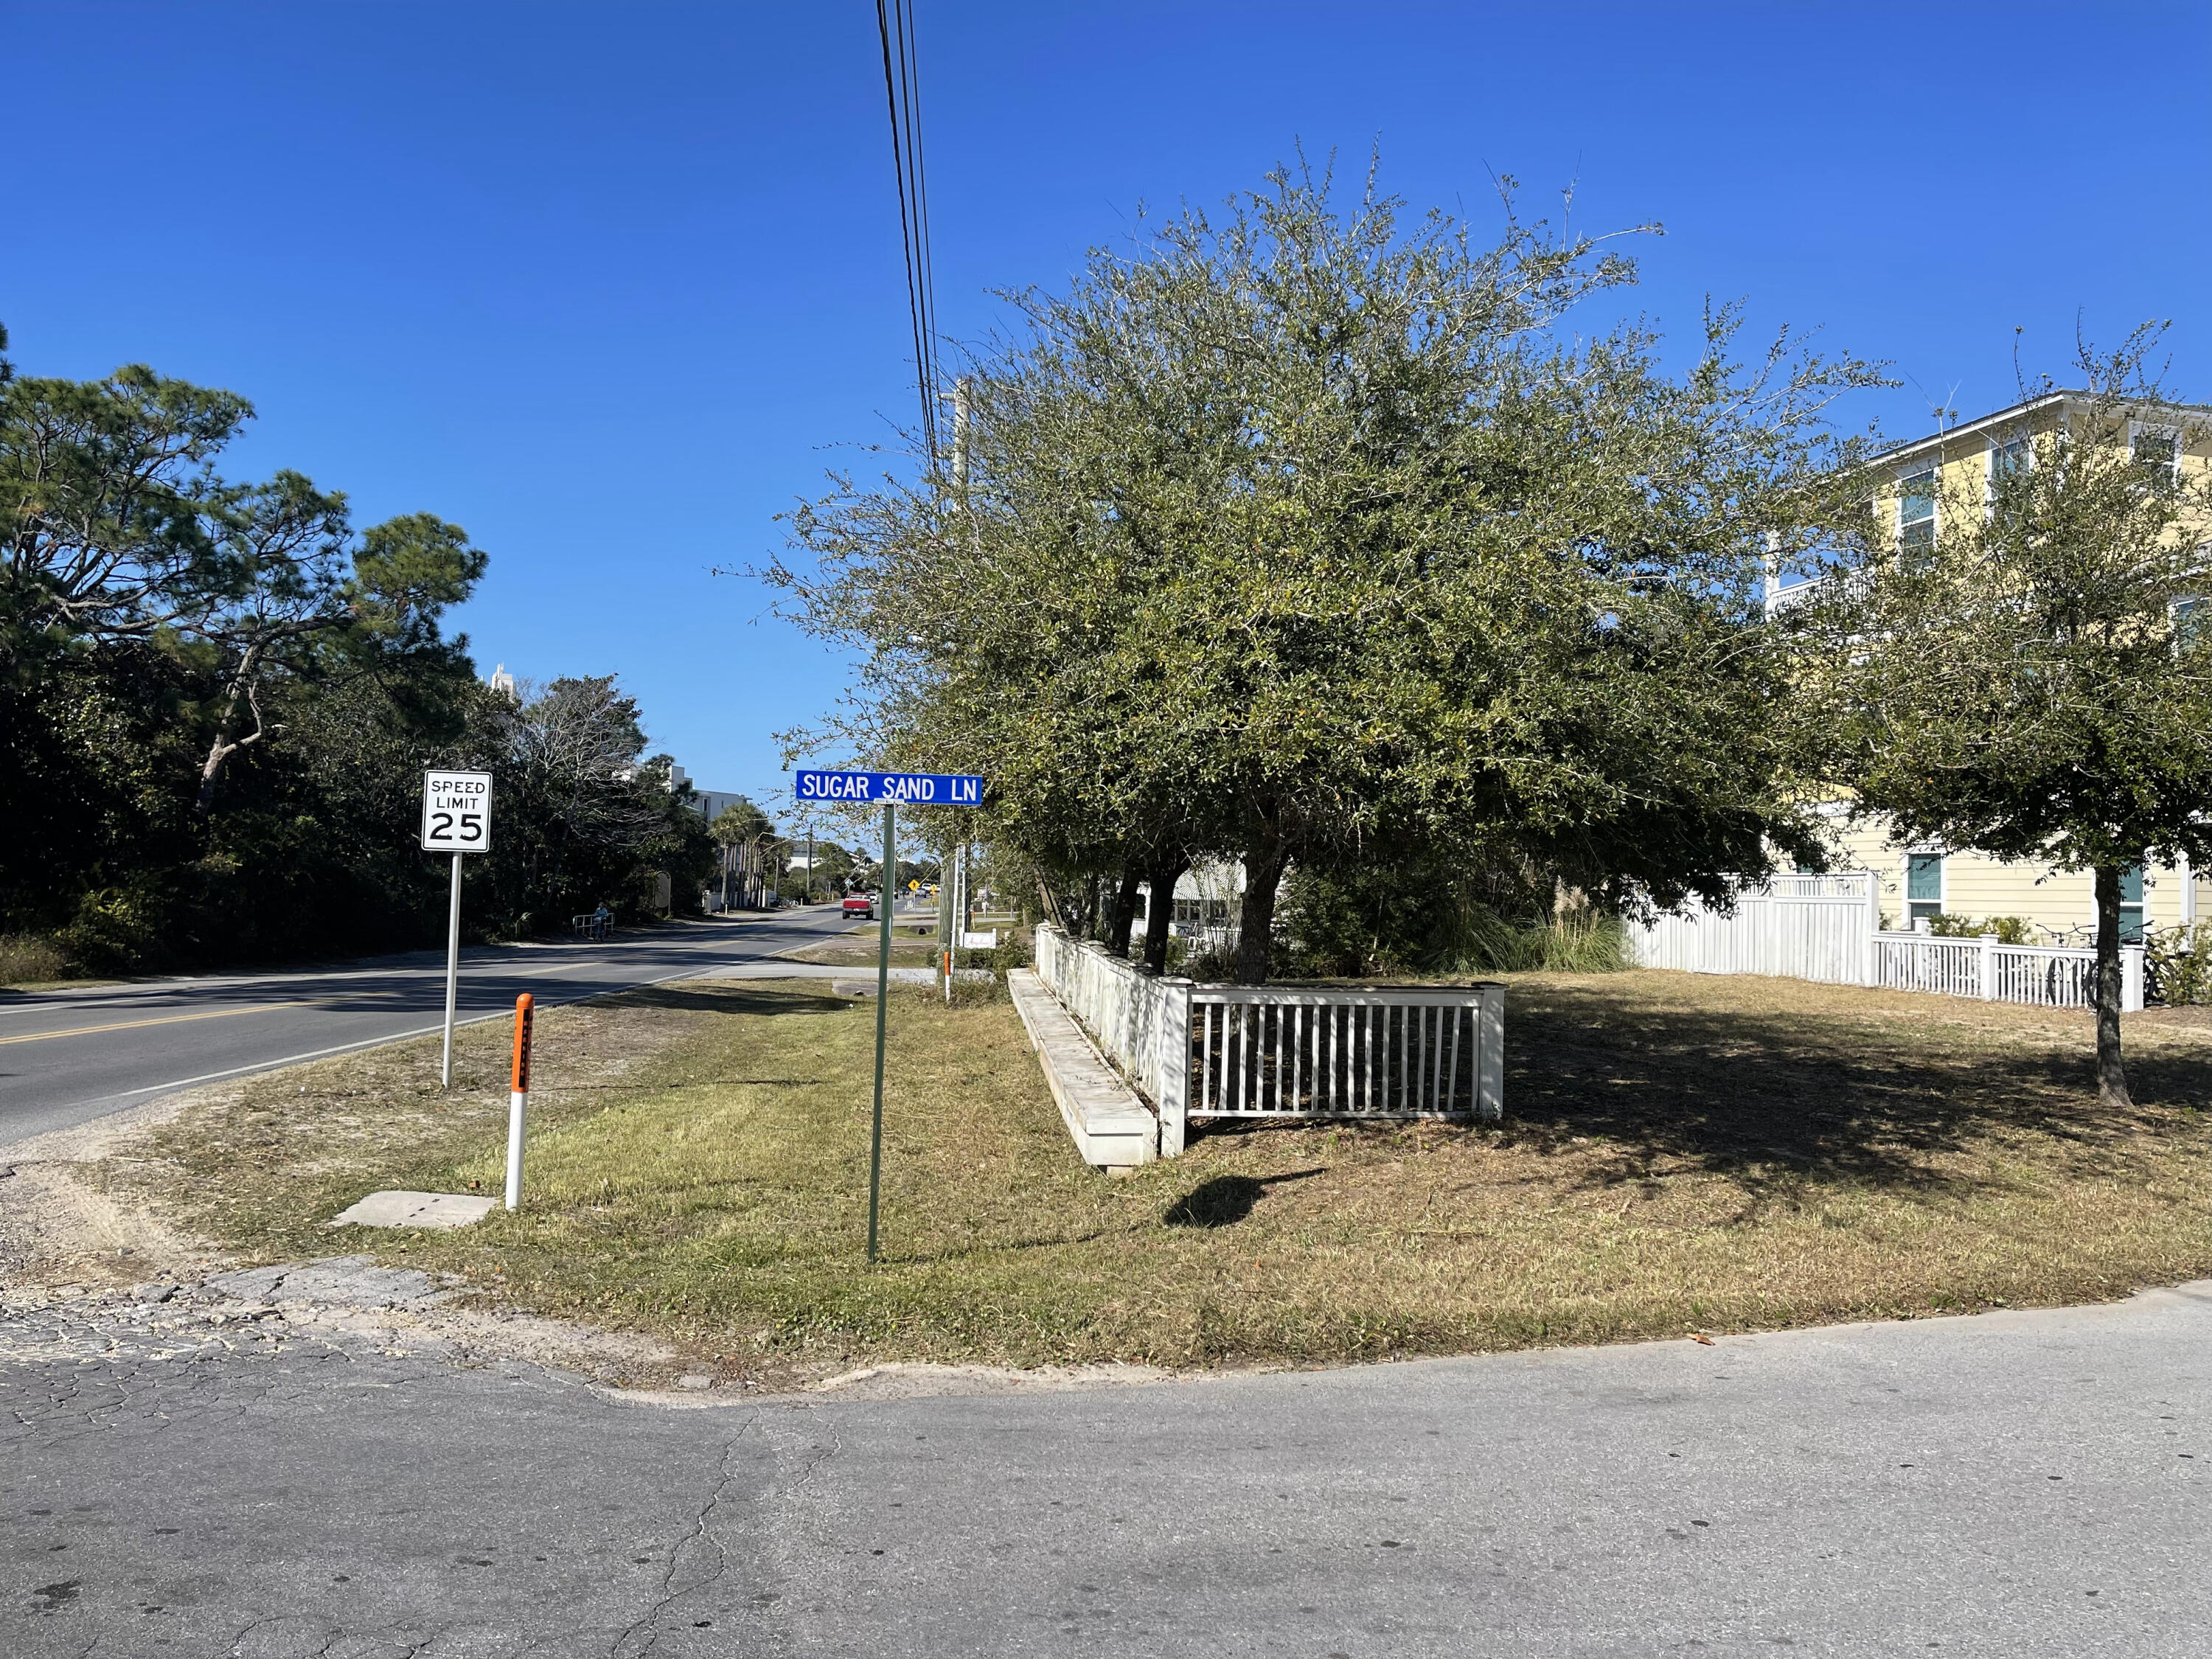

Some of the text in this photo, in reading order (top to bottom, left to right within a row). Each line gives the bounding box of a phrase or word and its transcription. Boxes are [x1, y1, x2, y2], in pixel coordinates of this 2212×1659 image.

[431, 781, 485, 793] SPEED
[802, 774, 976, 801] SUGAR SAND LN
[437, 797, 479, 809] LIMIT
[430, 813, 481, 841] 25
